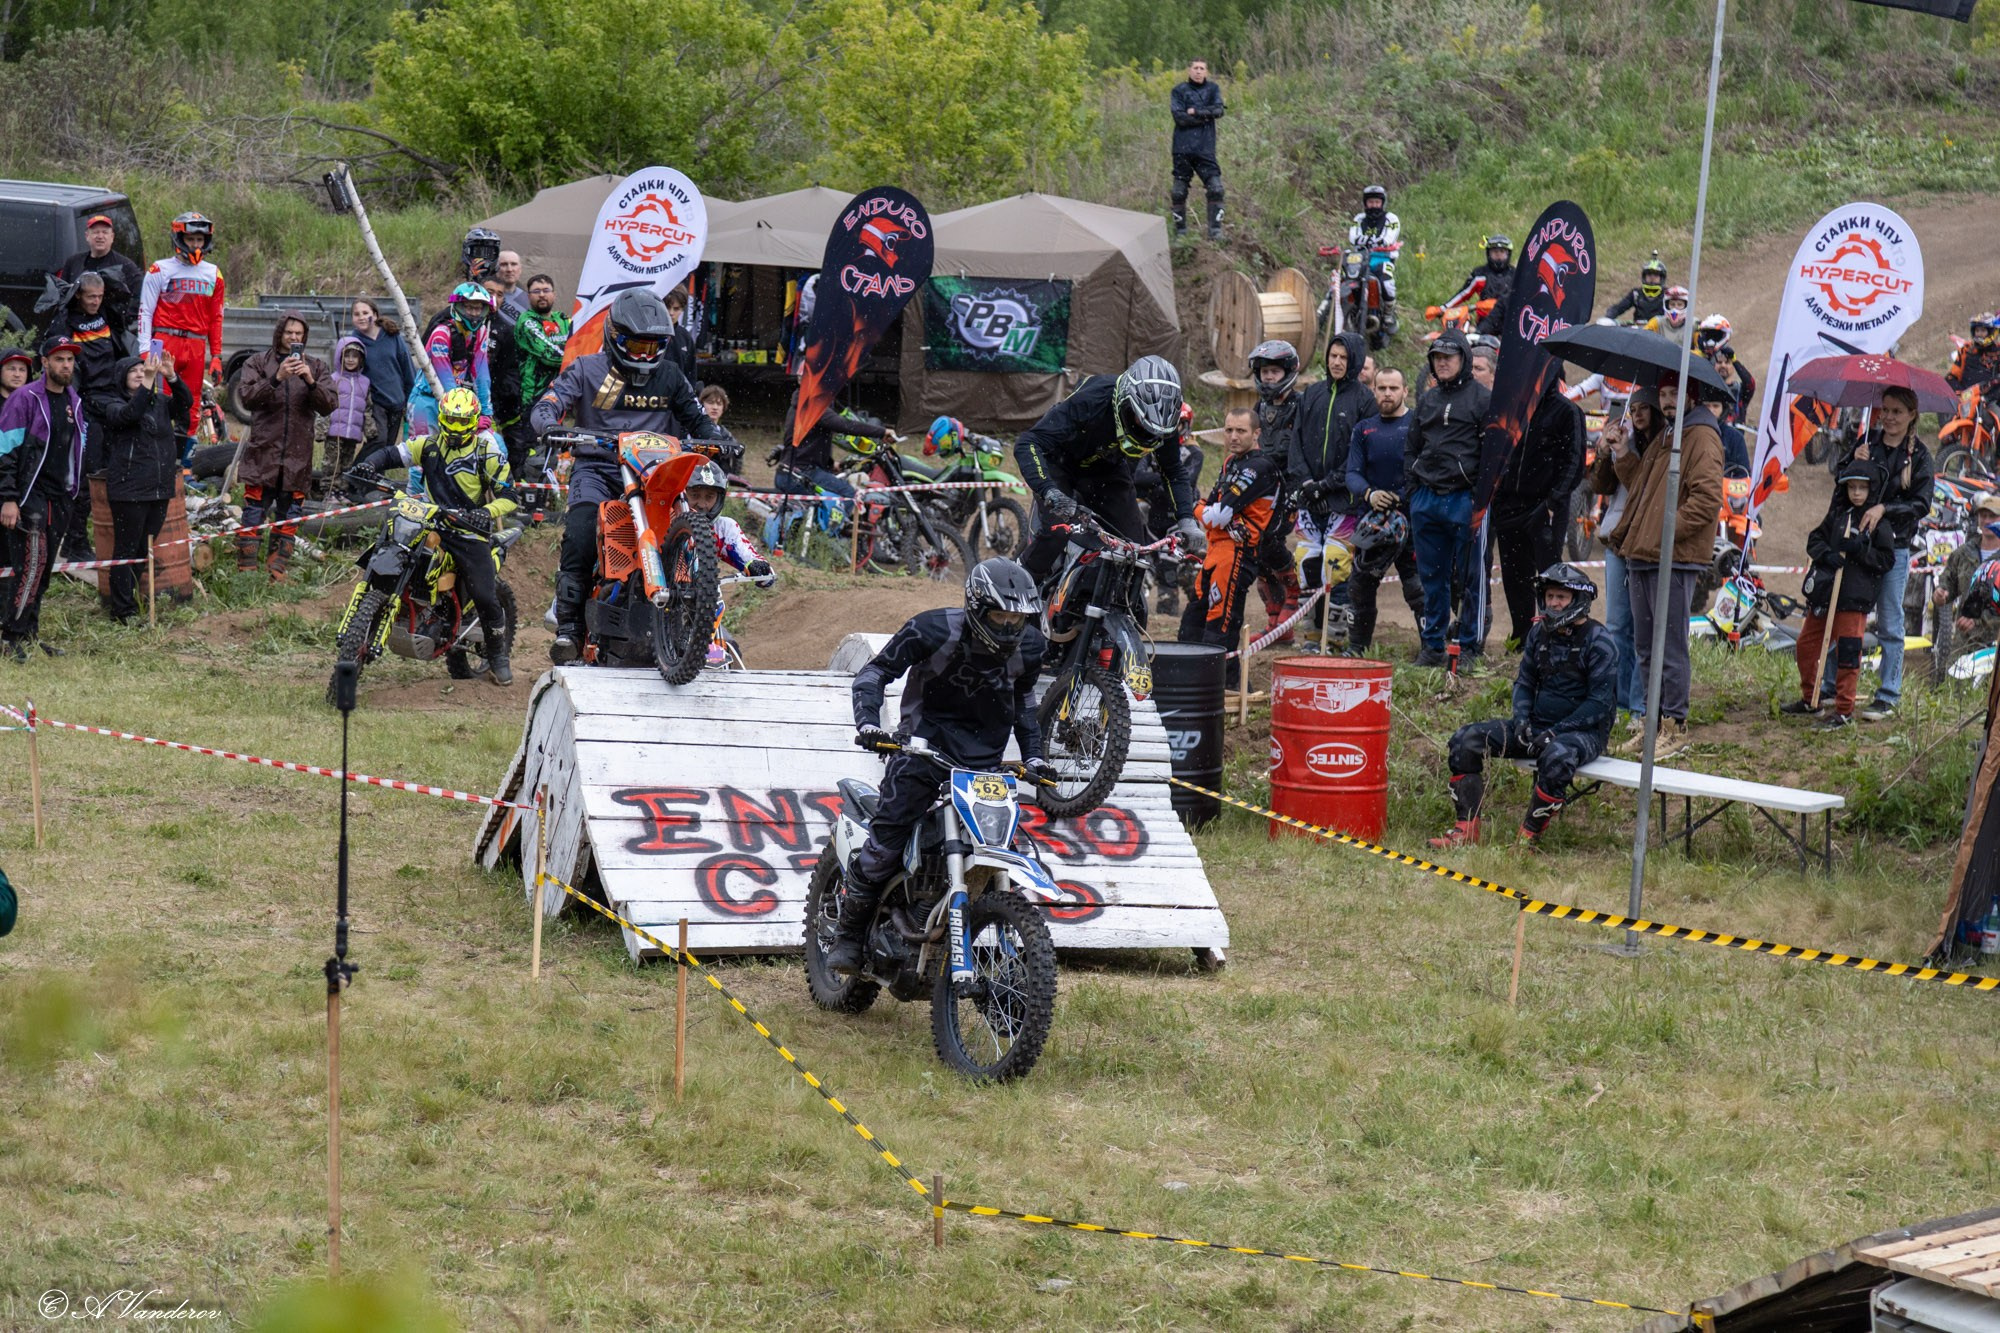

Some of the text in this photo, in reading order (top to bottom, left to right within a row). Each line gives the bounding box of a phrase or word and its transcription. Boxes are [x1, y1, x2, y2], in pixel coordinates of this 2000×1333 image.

[618, 179, 691, 209] СТАНКИ ЧПУ
[605, 219, 697, 245] HYPERCUT
[843, 197, 927, 240] ENDURO
[1527, 218, 1591, 275] ENDURO
[1815, 216, 1904, 253] СТАНКИ ЧПУ
[607, 245, 686, 275] ДЛЯ РЕЗКИ МЕТАЛЛА
[172, 279, 210, 293] LEATT
[1800, 265, 1915, 294] HYPERCUT
[1805, 296, 1902, 332] ДЛЯ РЕЗКИ МЕТАЛЛА
[1136, 676, 1149, 689] 45
[1308, 753, 1364, 766] SINTEC
[982, 782, 1000, 796] 62
[950, 908, 964, 968] PROGASI
